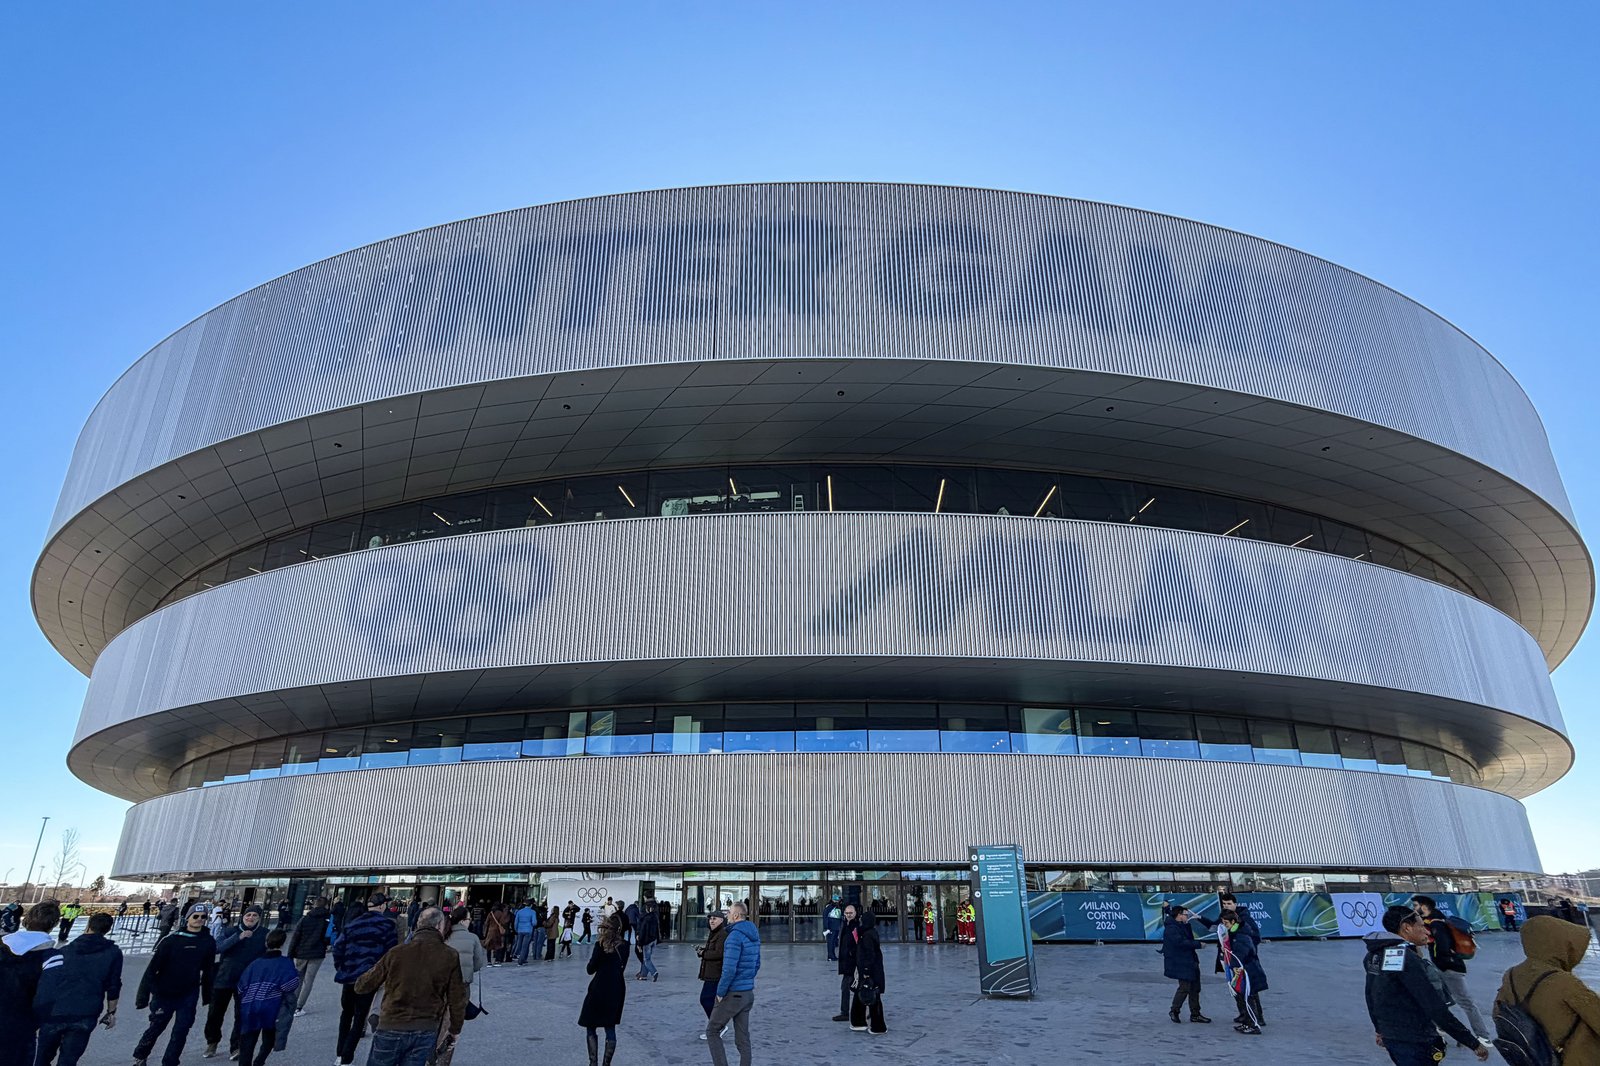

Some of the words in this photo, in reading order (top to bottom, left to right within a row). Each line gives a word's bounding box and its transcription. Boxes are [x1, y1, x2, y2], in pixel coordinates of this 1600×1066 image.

[872, 218, 1330, 374] GAME
[803, 522, 1366, 668] MILANO
[1079, 901, 1121, 910] MILANO
[1086, 911, 1130, 920] CORTINA
[1250, 911, 1271, 920] RTINA
[1095, 921, 1117, 930] 2026
